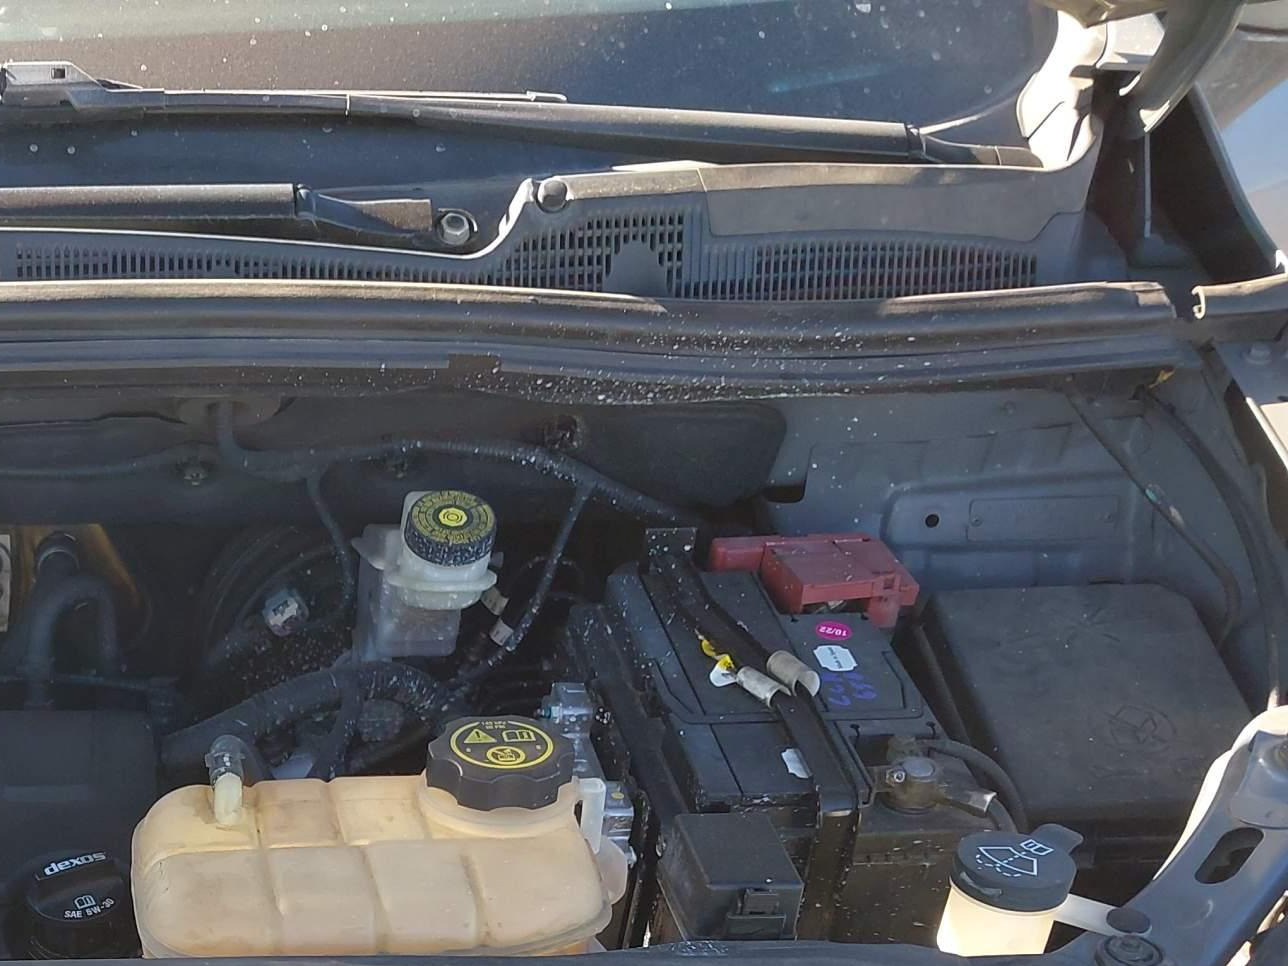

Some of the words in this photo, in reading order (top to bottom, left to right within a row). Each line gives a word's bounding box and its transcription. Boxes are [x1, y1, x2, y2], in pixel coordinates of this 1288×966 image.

[819, 626, 847, 636] 10/22
[44, 852, 107, 876] dexos
[64, 910, 83, 918] SAE
